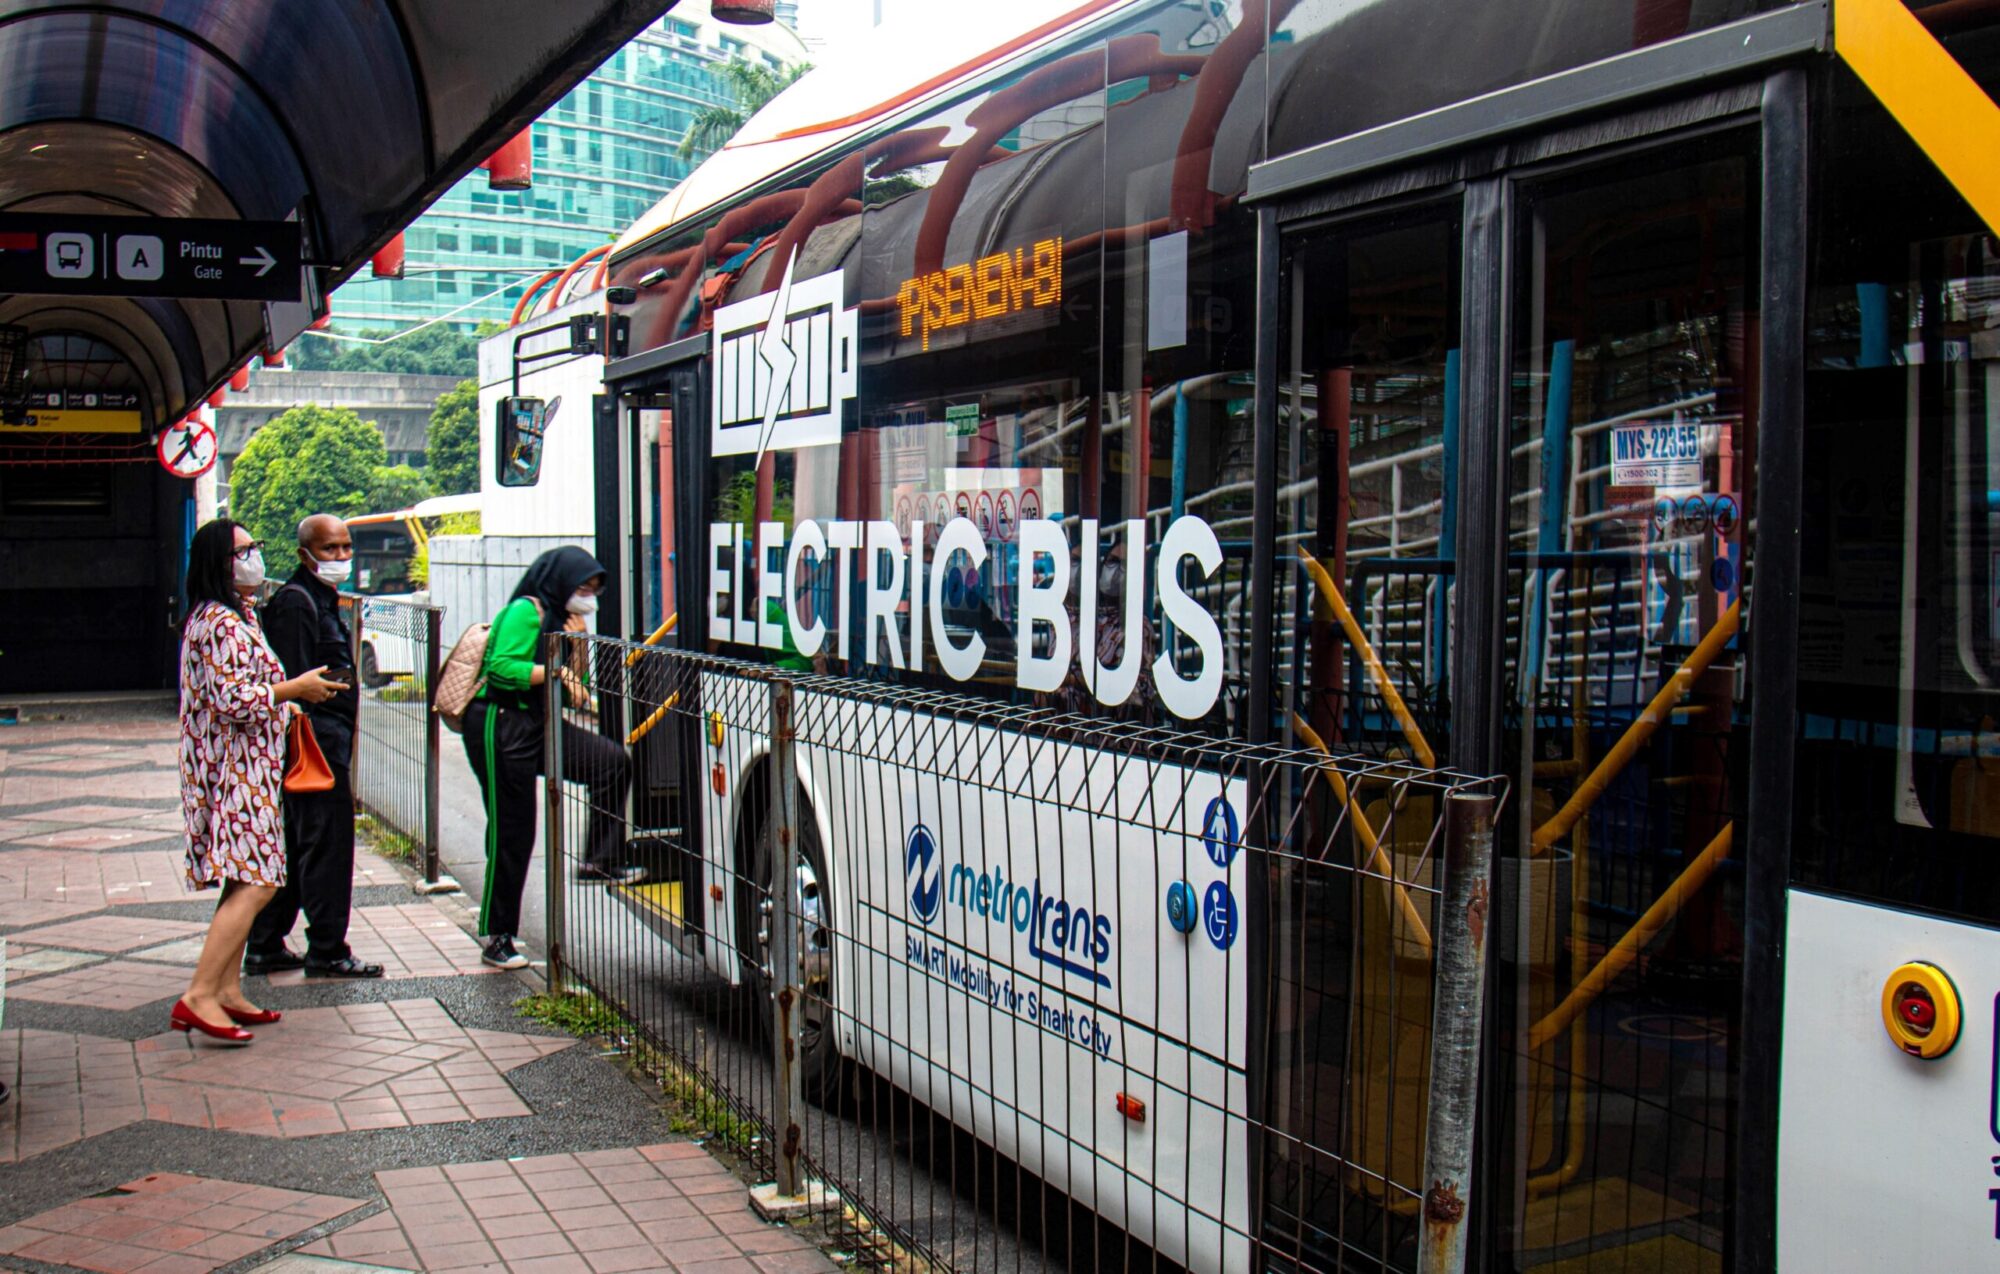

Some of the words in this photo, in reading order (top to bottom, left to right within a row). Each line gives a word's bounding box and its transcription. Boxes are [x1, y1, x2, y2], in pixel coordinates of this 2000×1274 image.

[132, 248, 148, 268] A
[180, 241, 222, 258] Pintu
[194, 265, 223, 280] Gate
[1617, 425, 1697, 460] MYS-22355
[1627, 469, 1658, 477] 1500-102
[709, 517, 987, 681] ELECTRIC
[1017, 515, 1224, 719] BUS
[949, 863, 1111, 989] metrotrans
[906, 935, 946, 976] SMART
[950, 957, 1001, 1005] Mobility
[1004, 982, 1023, 1013] for
[1028, 991, 1074, 1037] Smart
[1079, 1015, 1112, 1062] City
